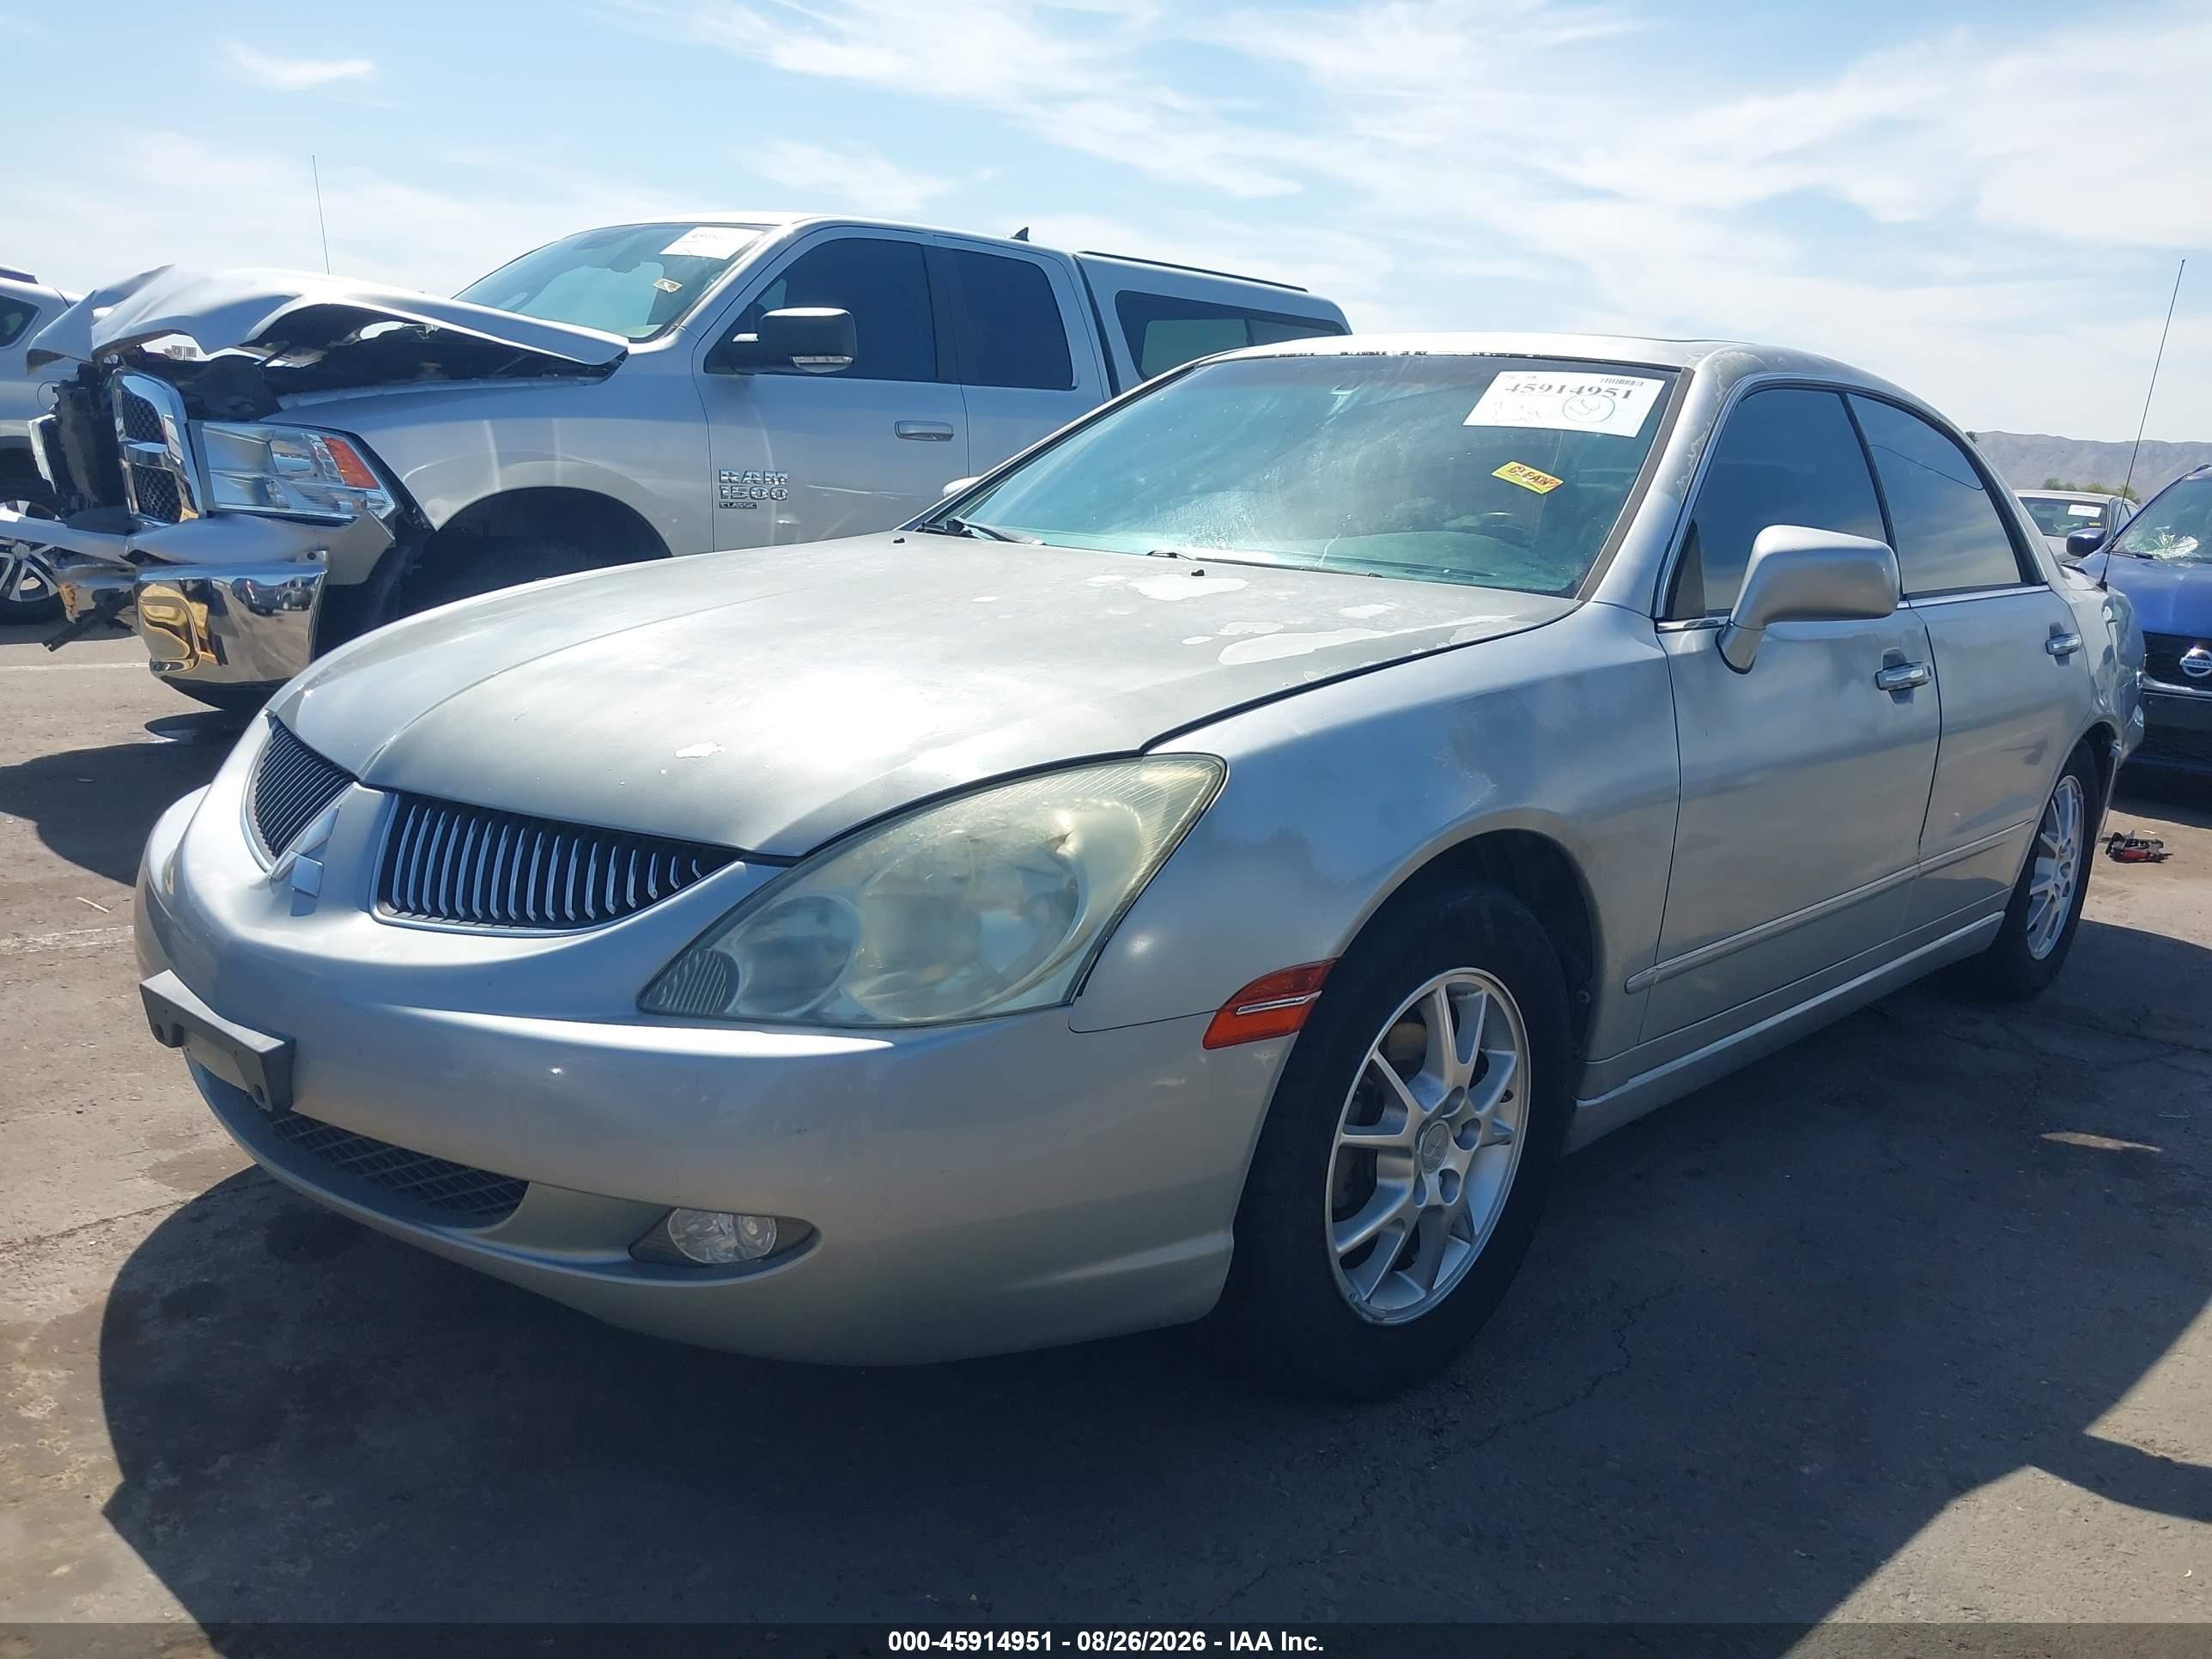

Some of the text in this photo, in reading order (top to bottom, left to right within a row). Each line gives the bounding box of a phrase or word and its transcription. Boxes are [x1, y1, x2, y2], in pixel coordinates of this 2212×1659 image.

[1504, 383, 1634, 400] 45914951
[720, 469, 788, 486] RAM
[720, 485, 788, 501] 1500
